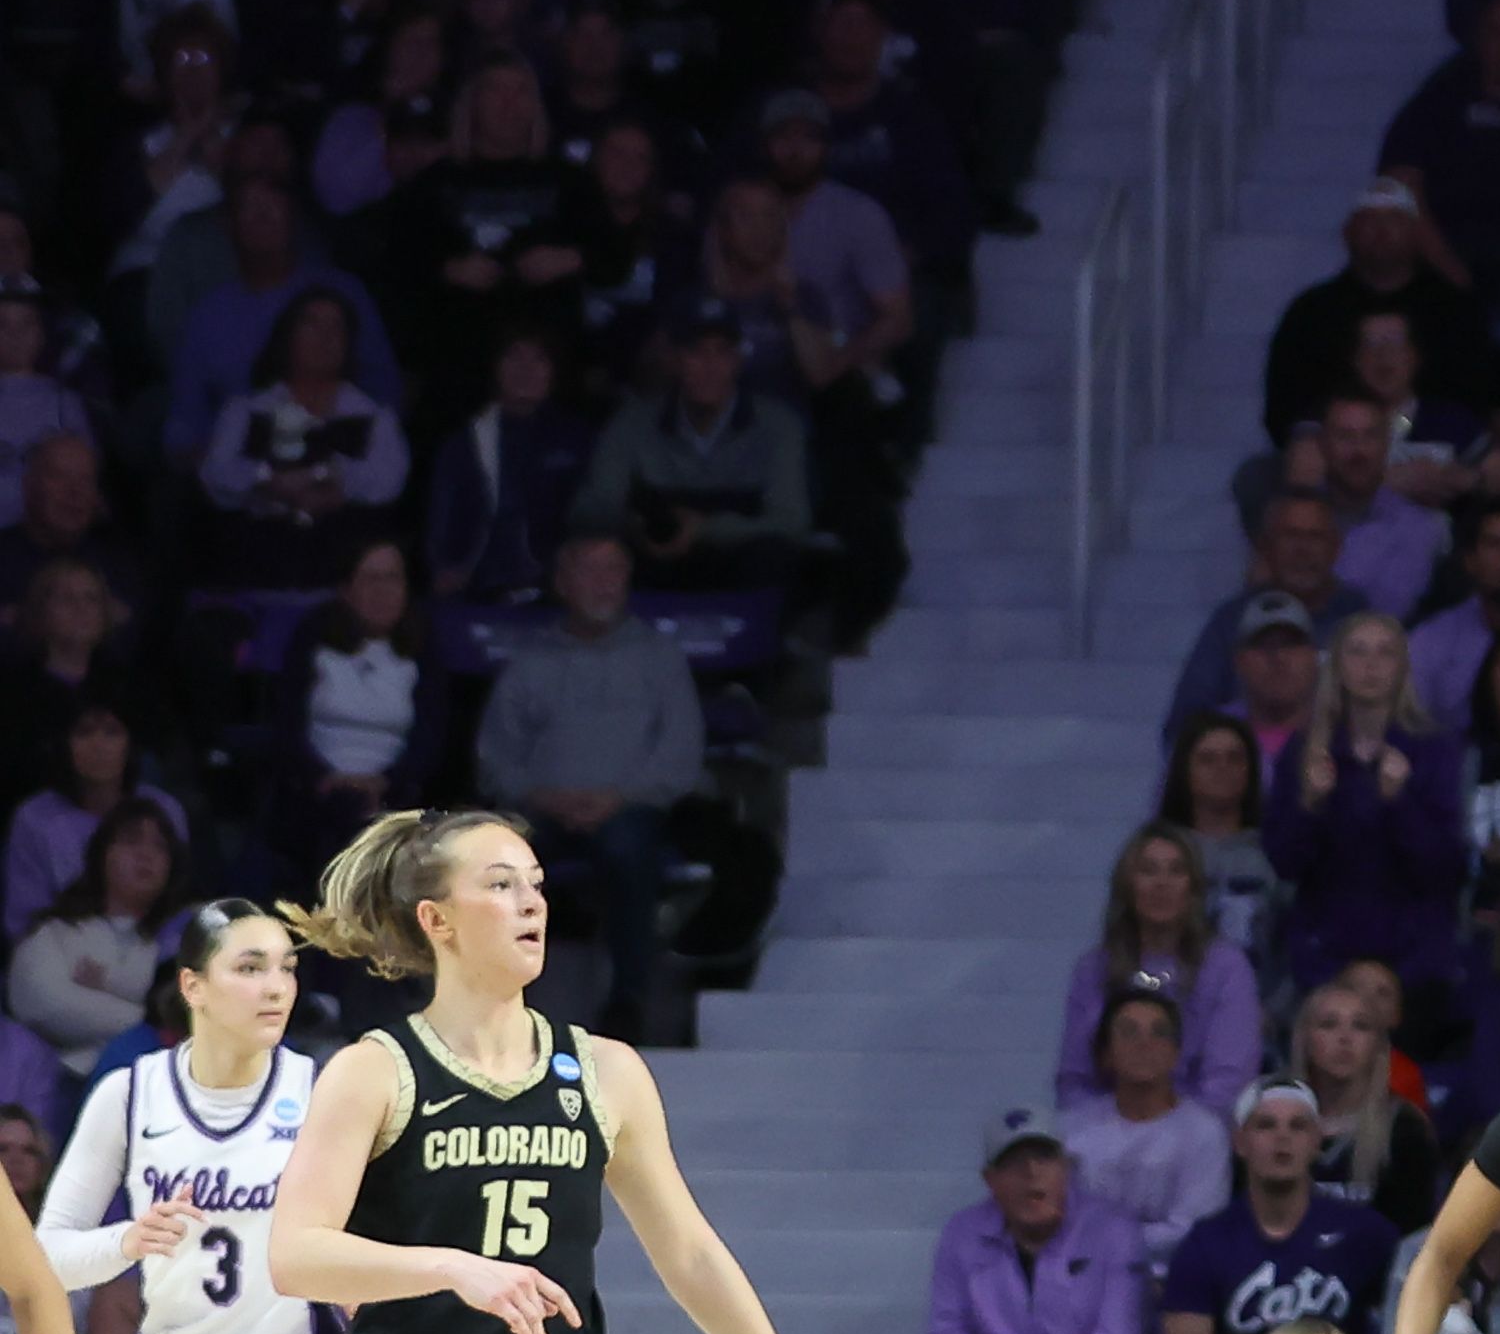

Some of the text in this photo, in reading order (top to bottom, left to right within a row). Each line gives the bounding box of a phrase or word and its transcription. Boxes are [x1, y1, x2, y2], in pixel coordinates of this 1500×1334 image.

[423, 1125, 588, 1171] COLORADO
[480, 1179, 551, 1258] 15
[200, 1225, 242, 1307] 3
